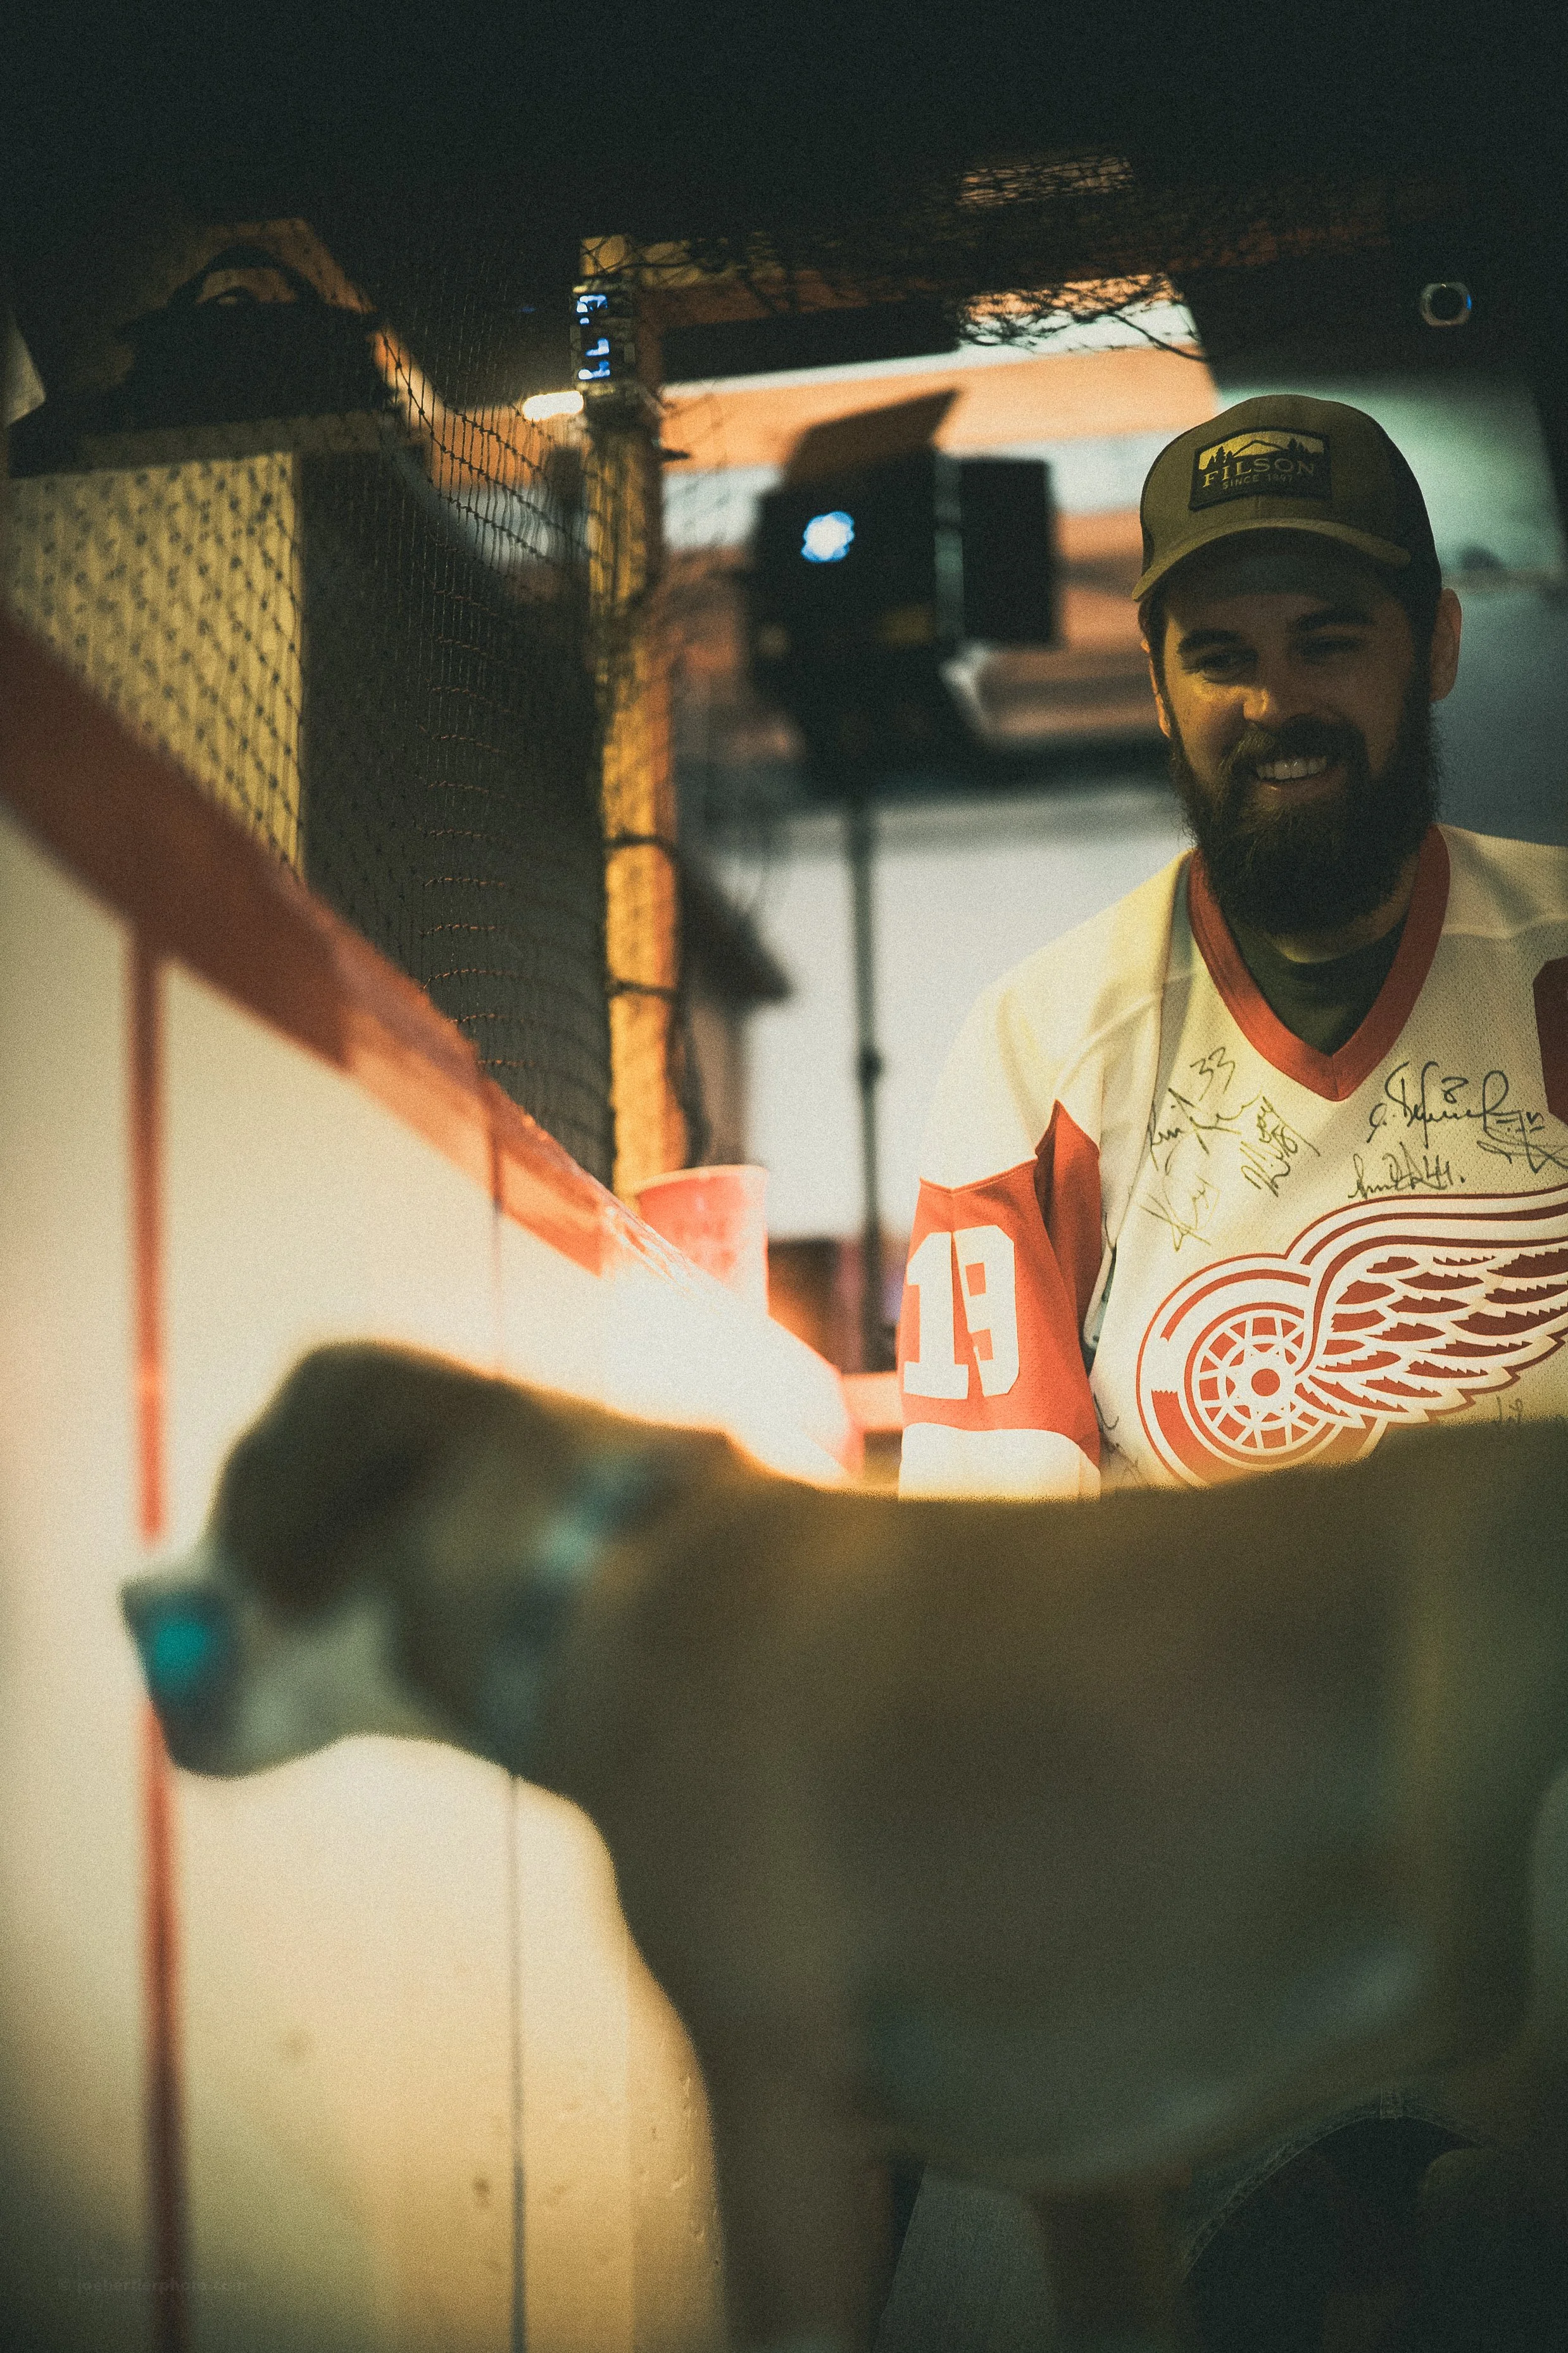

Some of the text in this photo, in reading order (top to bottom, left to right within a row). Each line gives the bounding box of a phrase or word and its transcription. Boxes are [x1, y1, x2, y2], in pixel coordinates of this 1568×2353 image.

[1203, 458, 1314, 488] FILSON
[1222, 474, 1259, 489] SINCE
[1189, 1046, 1236, 1101] 33
[903, 1225, 1020, 1400] 19
